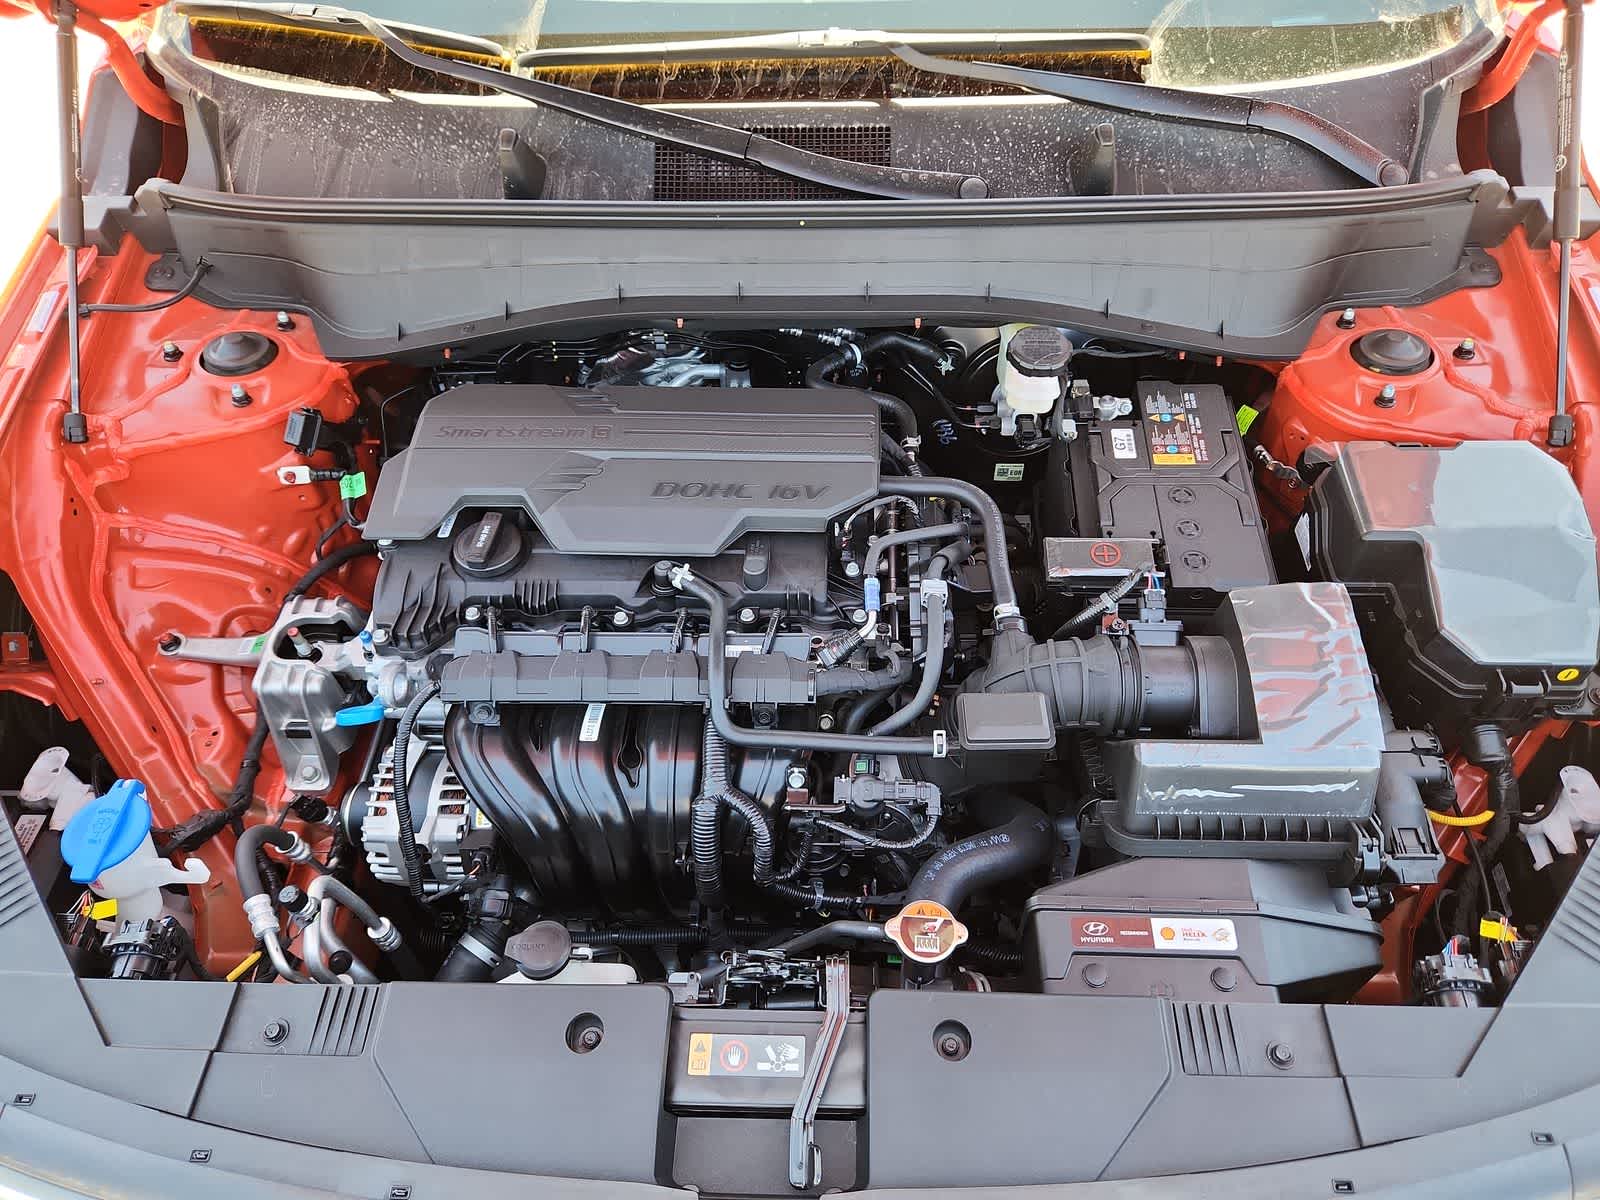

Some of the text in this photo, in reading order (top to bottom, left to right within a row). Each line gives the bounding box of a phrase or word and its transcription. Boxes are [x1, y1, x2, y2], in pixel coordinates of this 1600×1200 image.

[434, 425, 586, 439] Smartstream
[650, 481, 831, 502] DOHC 16V
[1080, 936, 1114, 944] HYUNDAI
